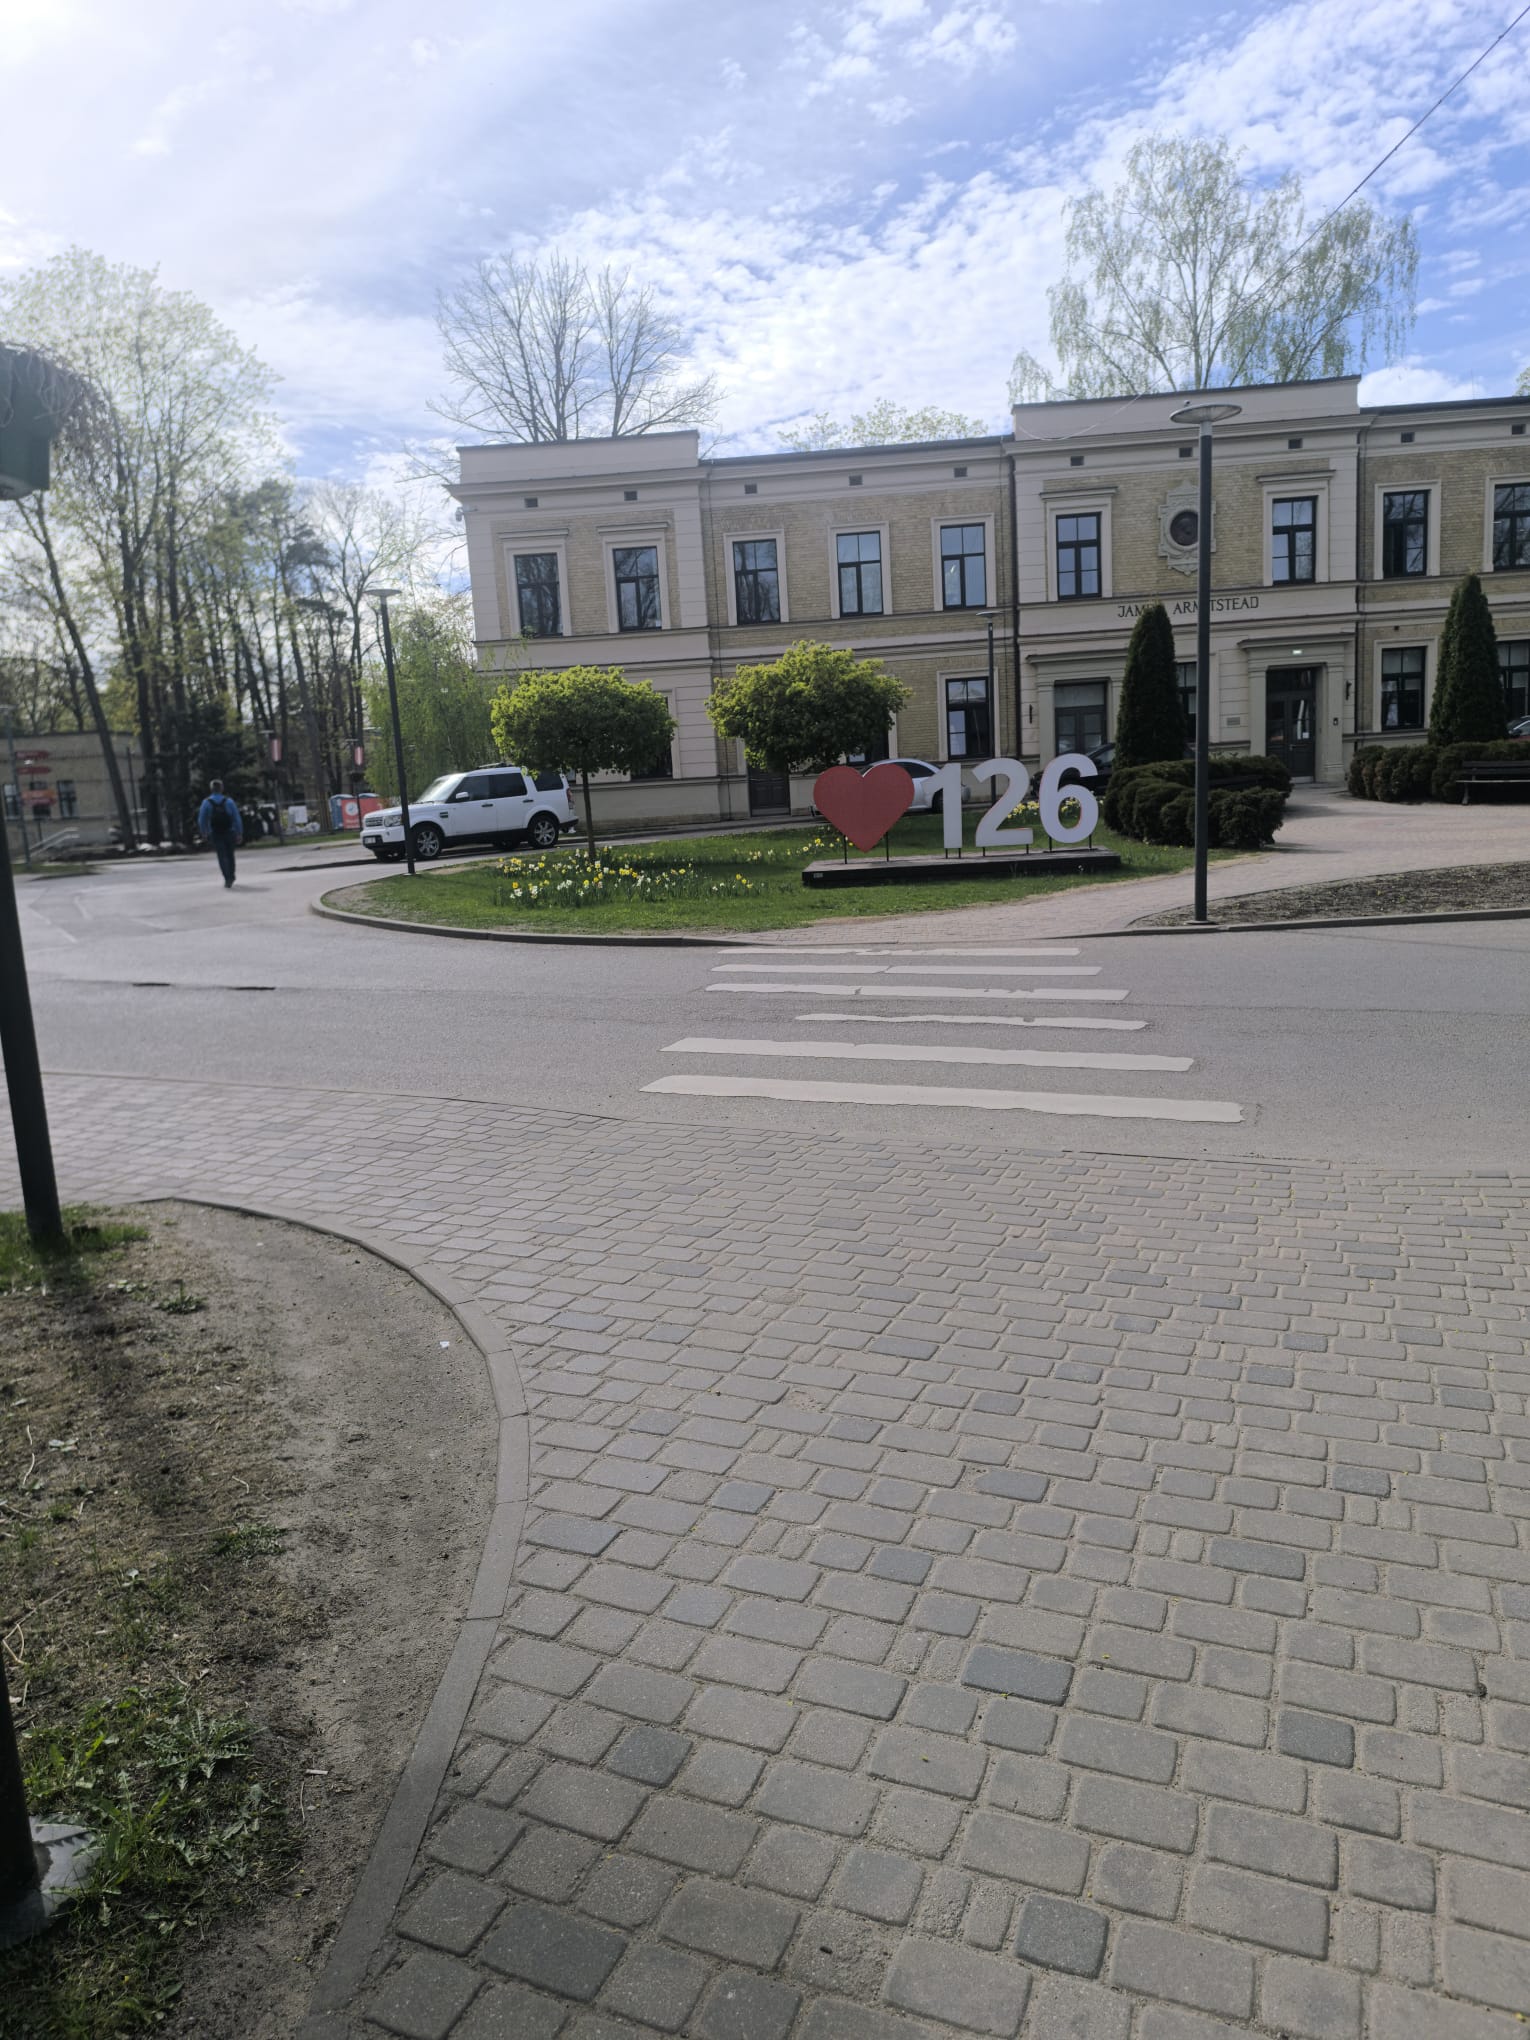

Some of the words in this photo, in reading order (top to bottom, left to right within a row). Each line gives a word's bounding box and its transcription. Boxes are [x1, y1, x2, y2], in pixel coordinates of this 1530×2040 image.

[1117, 602, 1157, 617] JAM
[1172, 596, 1259, 615] ARMTSTEAD
[921, 753, 1099, 849] 126
